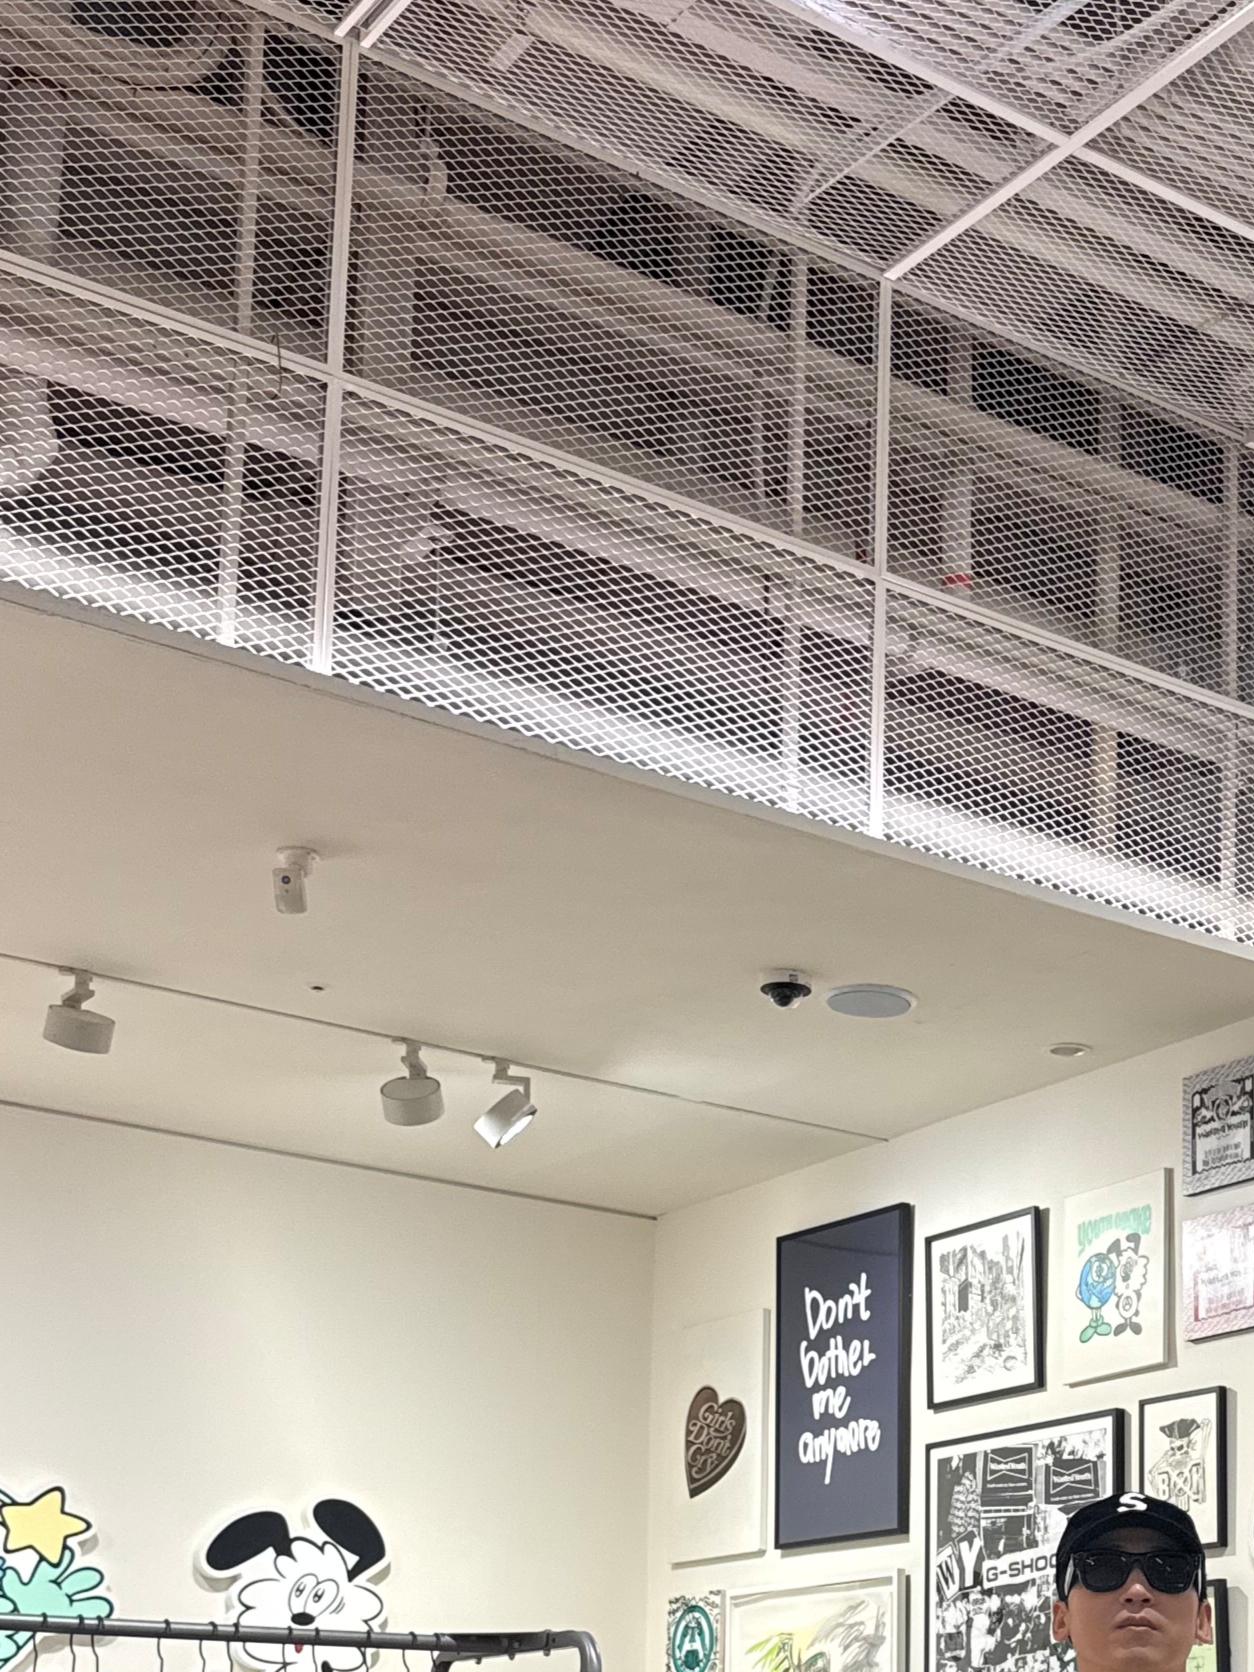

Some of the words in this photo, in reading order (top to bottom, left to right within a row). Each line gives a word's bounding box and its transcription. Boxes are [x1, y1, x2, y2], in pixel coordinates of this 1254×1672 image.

[804, 1273, 871, 1339] Don't
[800, 1335, 876, 1388] bother
[698, 1402, 736, 1437] Girls
[812, 1385, 851, 1420] me
[687, 1444, 718, 1479] Cry
[799, 1417, 880, 1485] anymore
